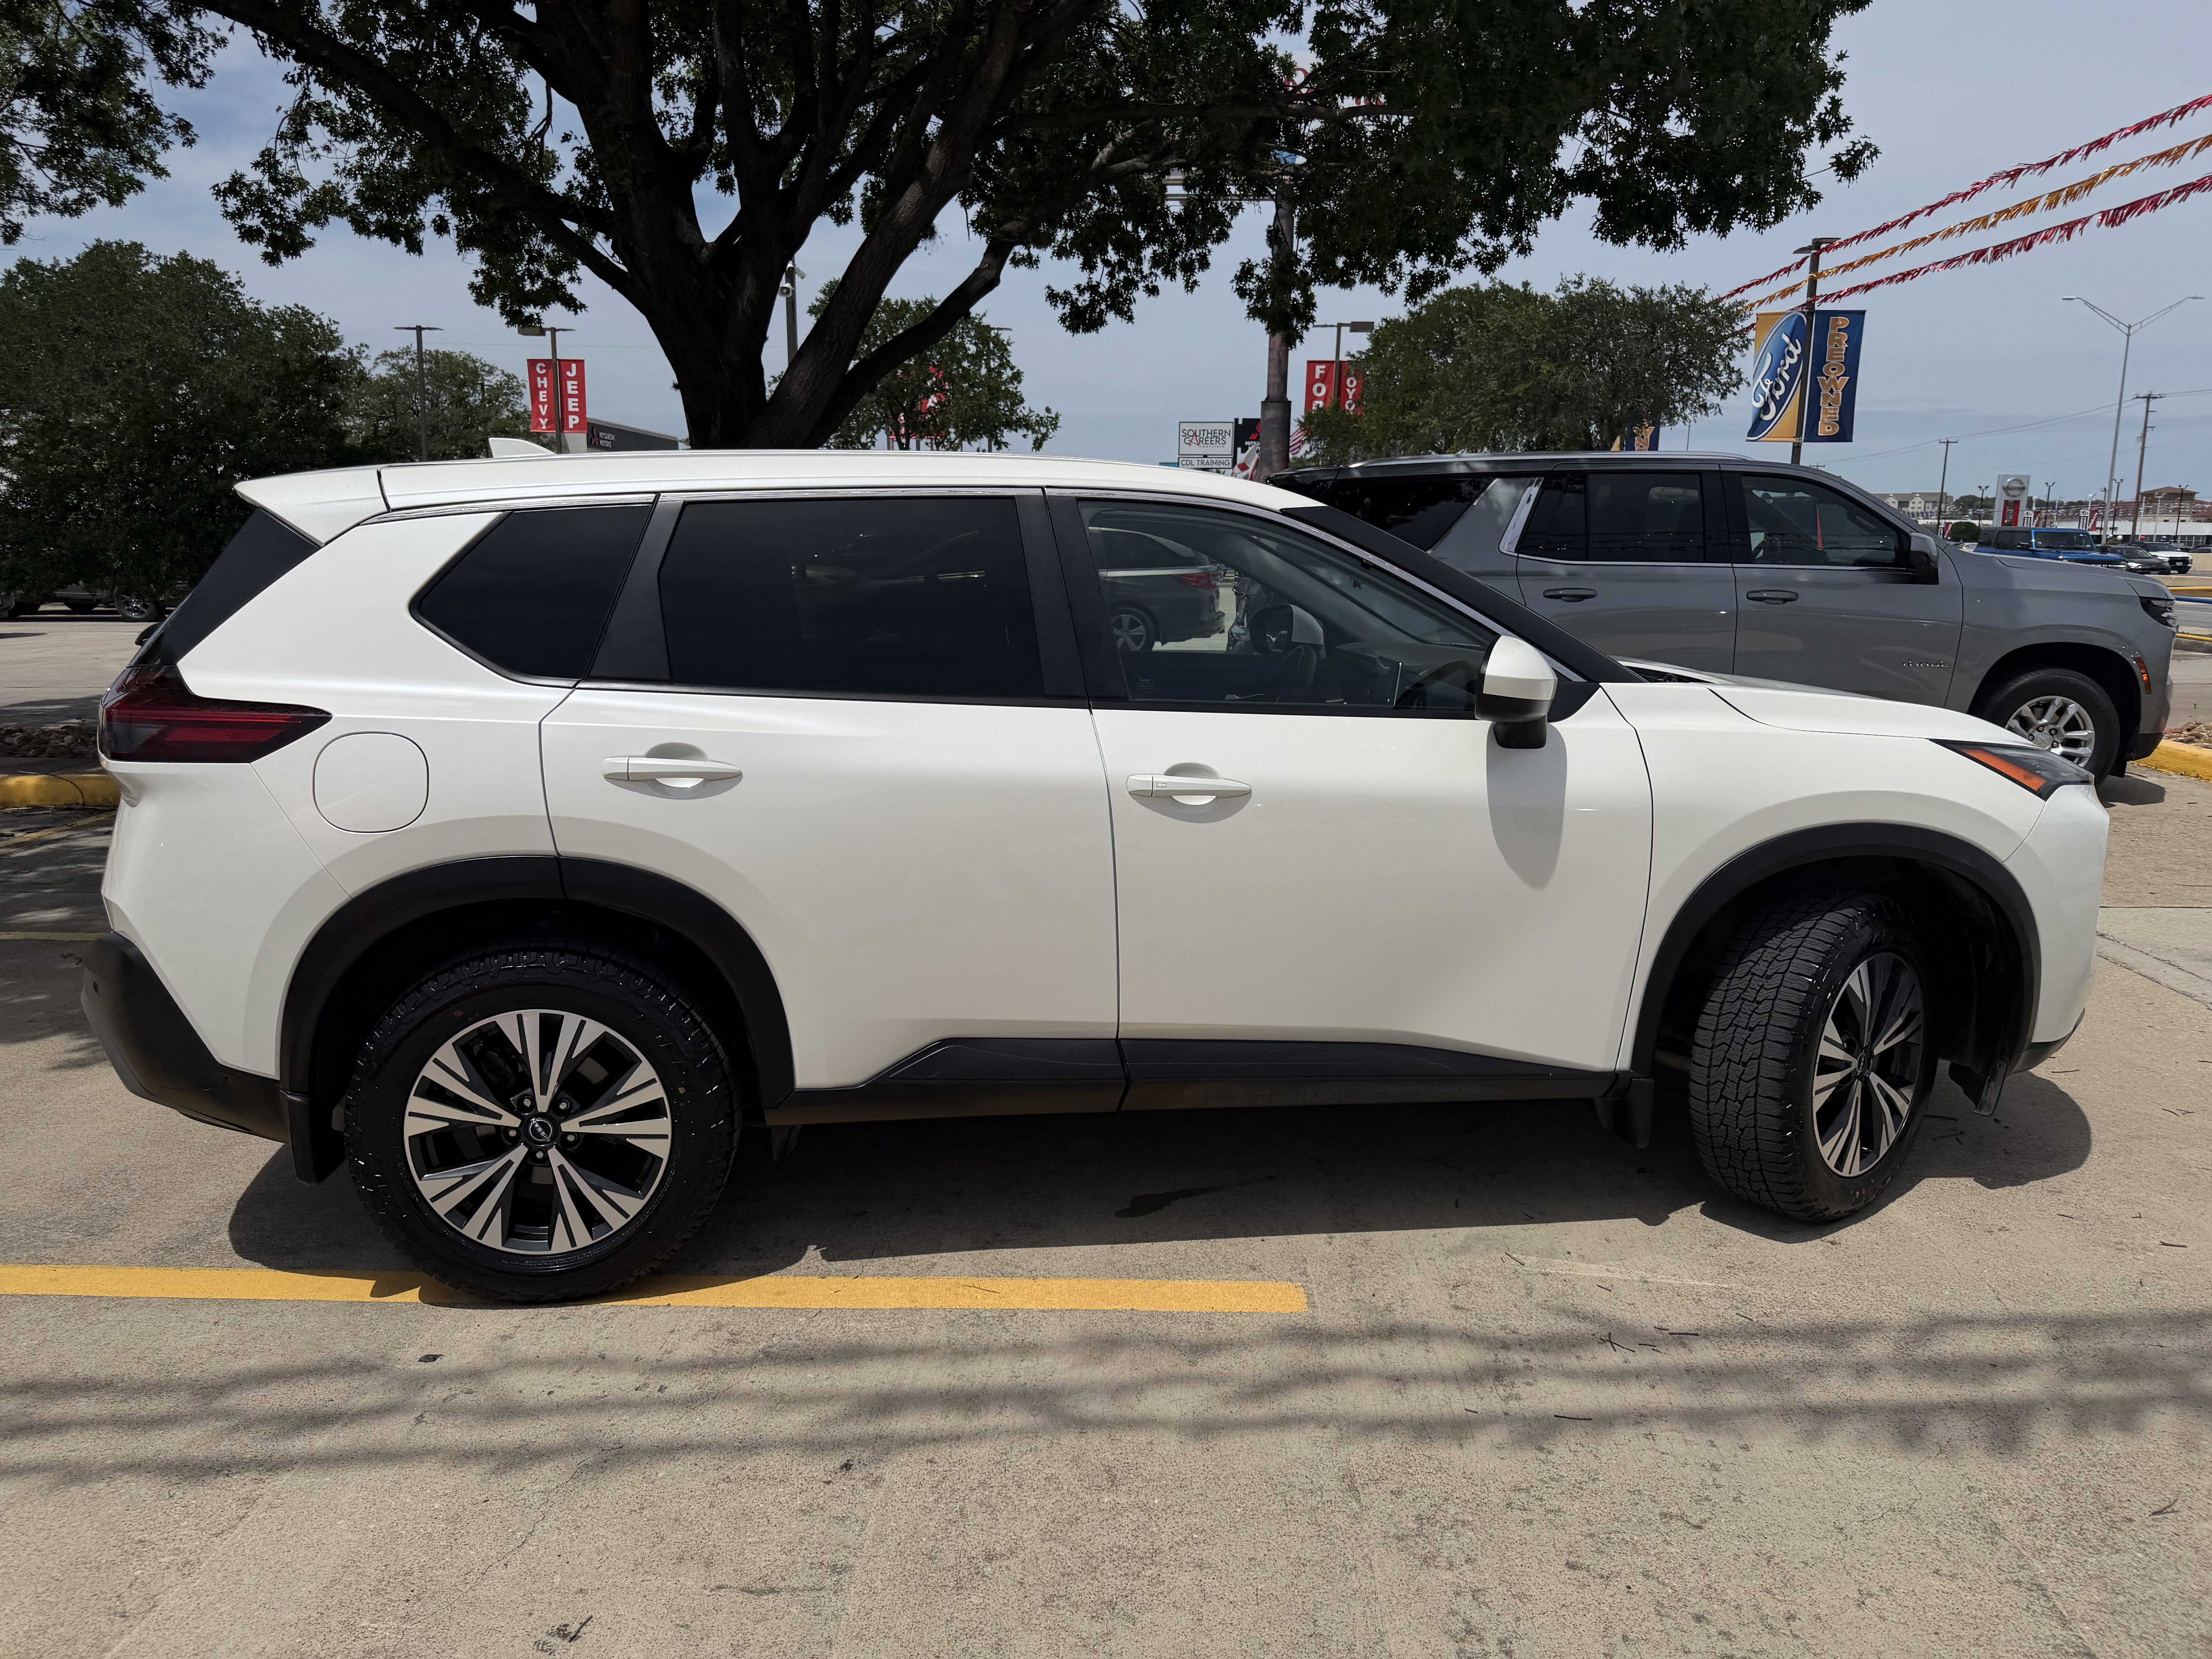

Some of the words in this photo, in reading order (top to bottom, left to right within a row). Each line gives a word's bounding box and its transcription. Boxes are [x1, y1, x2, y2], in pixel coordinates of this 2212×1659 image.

[536, 362, 548, 429] CHEVY
[566, 363, 580, 429] JEEP
[1312, 365, 1326, 410] FOR
[1752, 333, 1802, 421] Ford
[1818, 316, 1850, 436] PREOWNED
[1182, 429, 1231, 438] SOUTHERN
[1184, 433, 1226, 446] CAREERS
[531, 1118, 551, 1142] NISSAN
